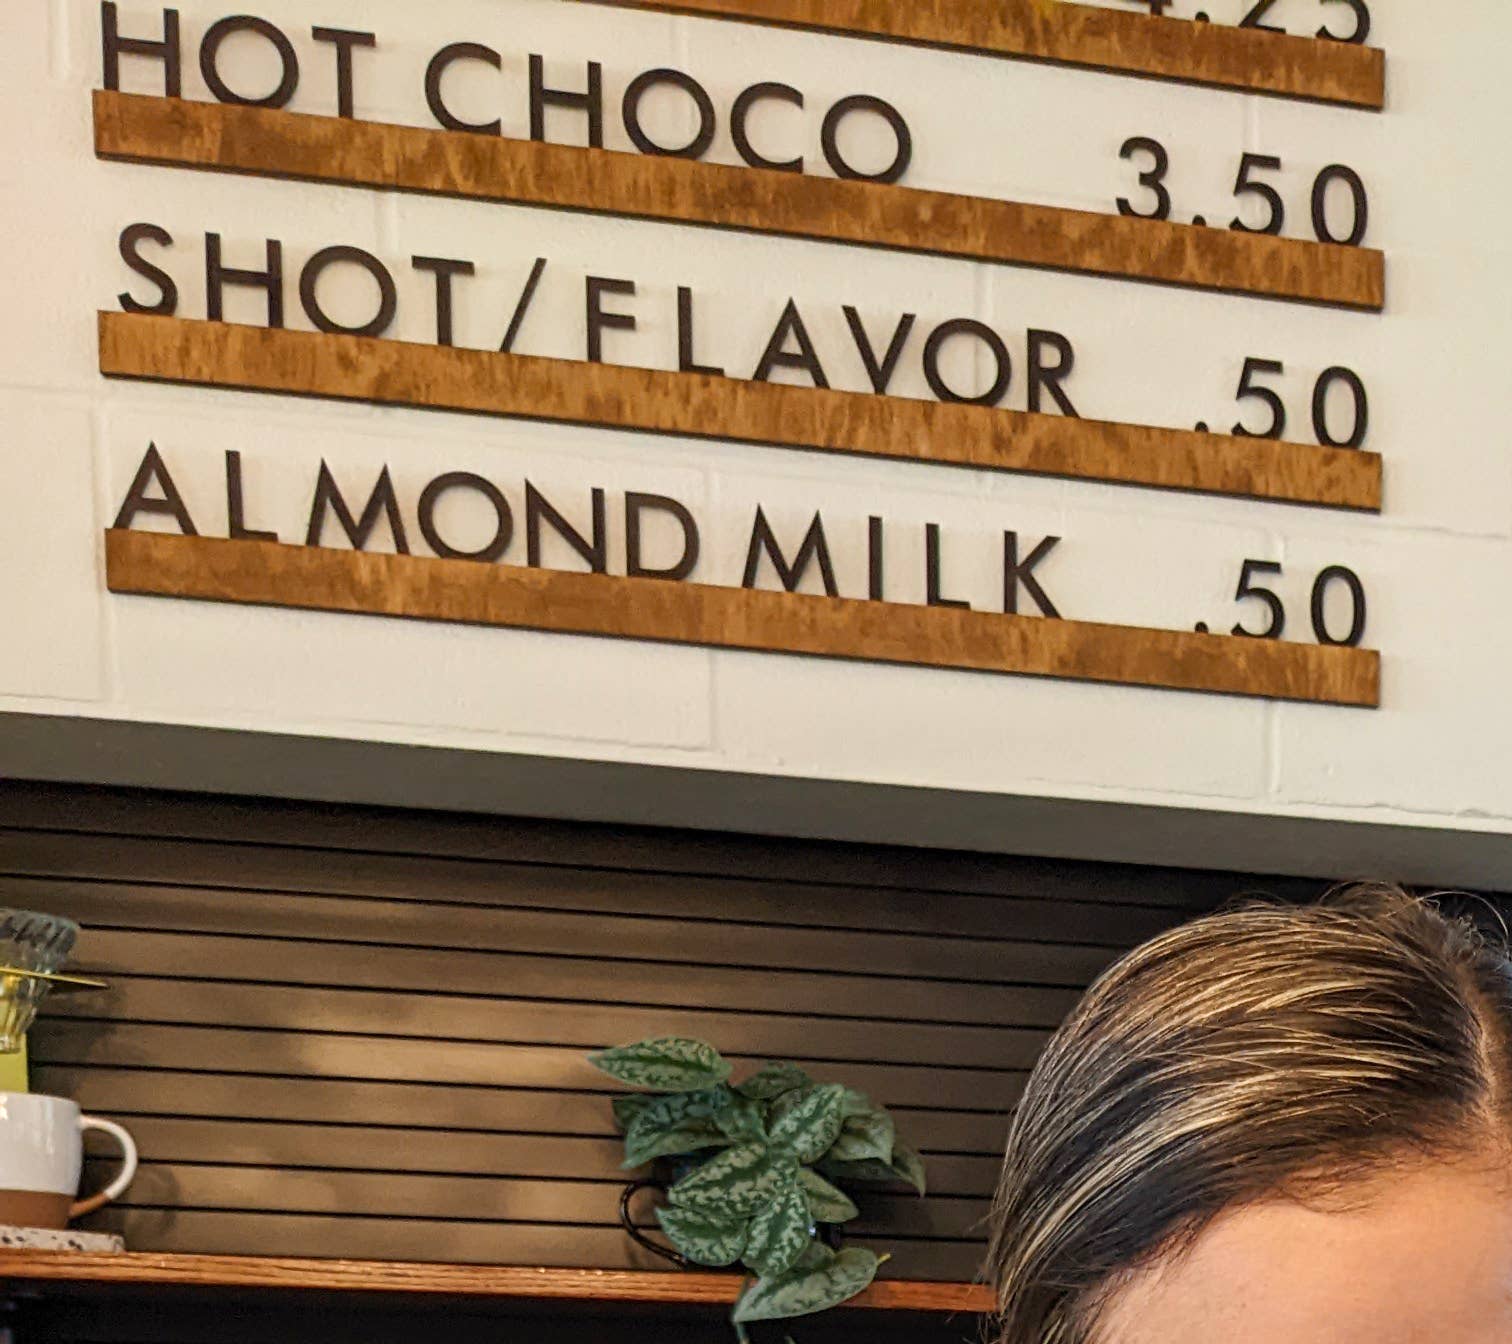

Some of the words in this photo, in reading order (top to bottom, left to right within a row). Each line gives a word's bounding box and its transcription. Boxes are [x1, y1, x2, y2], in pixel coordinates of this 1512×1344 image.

[101, 0, 376, 120] HOT
[424, 41, 914, 185] CHOCO
[1114, 136, 1370, 248] 3.50
[1192, 356, 1370, 450] .50
[112, 442, 701, 581] ALMOND
[741, 504, 1068, 622] MILK
[1192, 557, 1368, 649] .50
